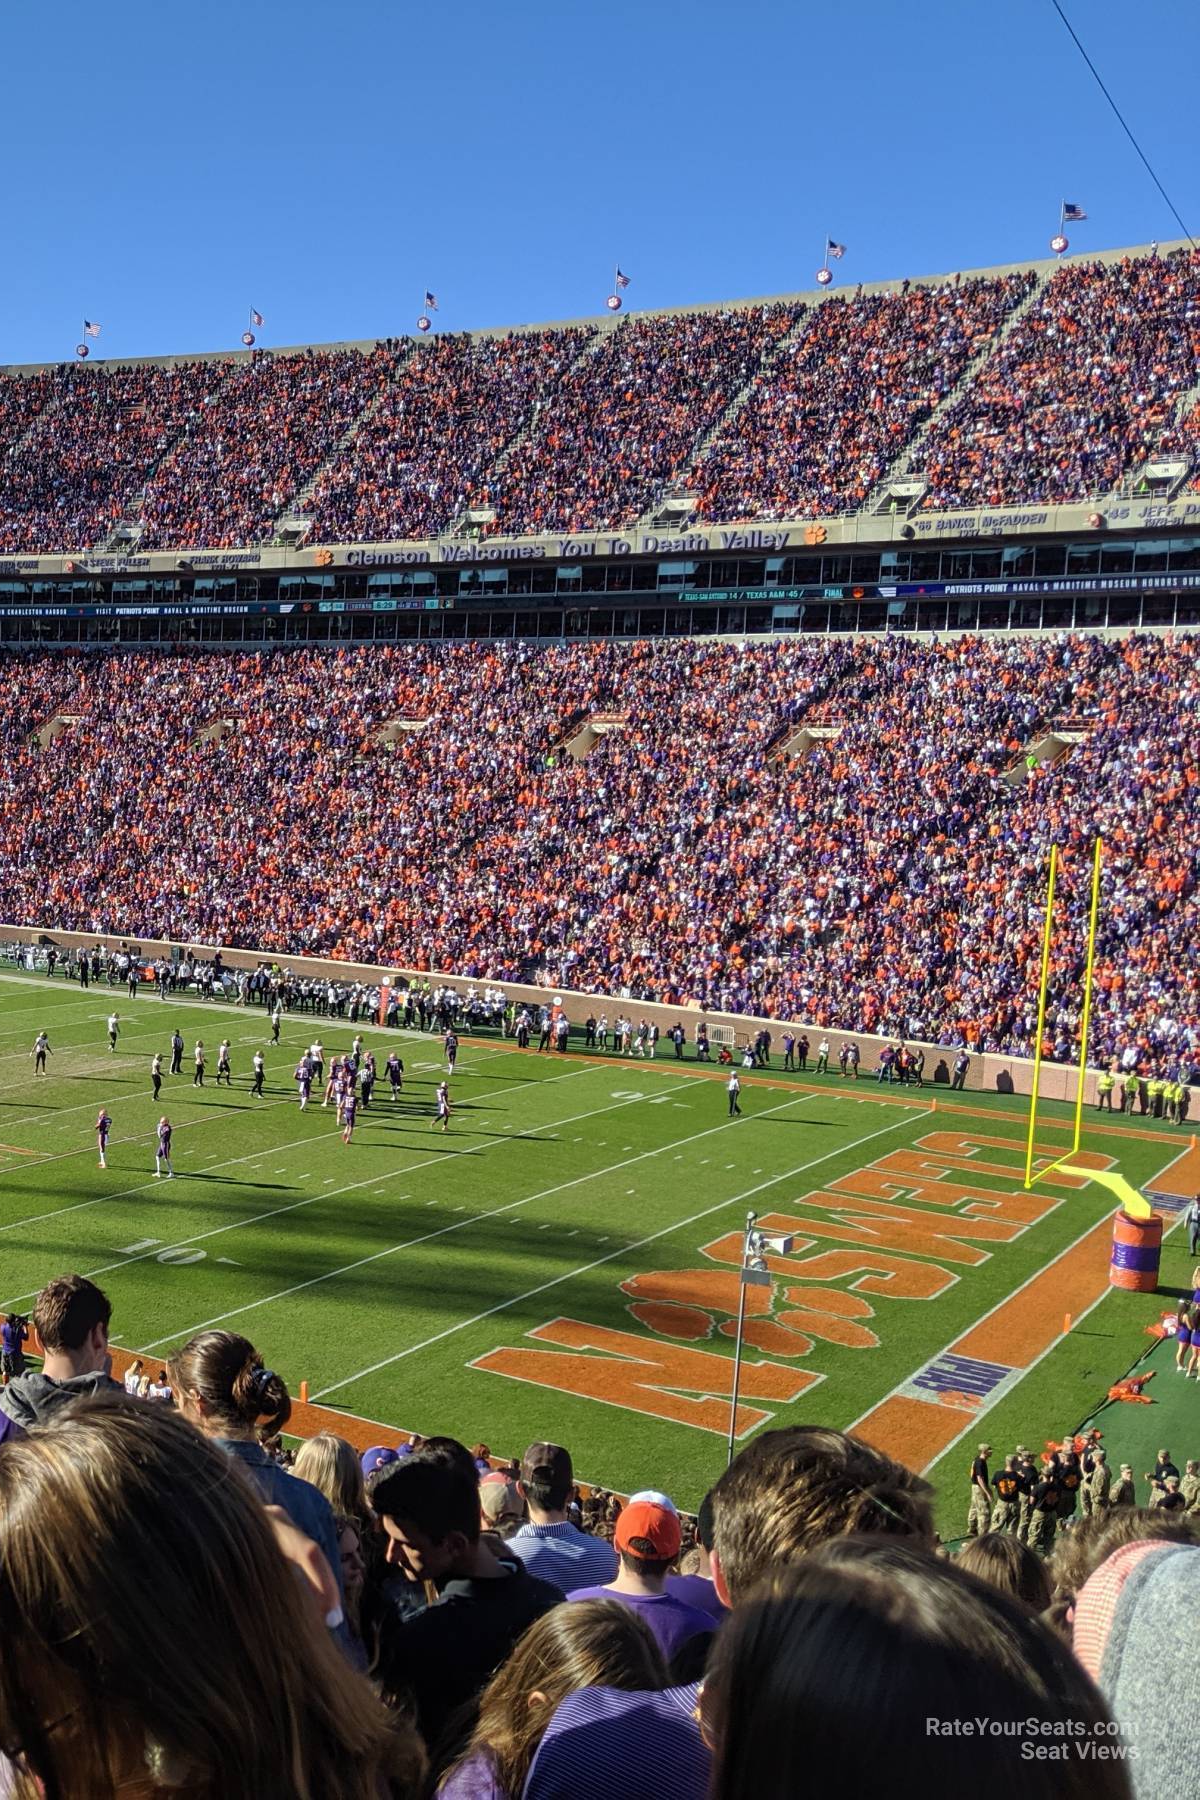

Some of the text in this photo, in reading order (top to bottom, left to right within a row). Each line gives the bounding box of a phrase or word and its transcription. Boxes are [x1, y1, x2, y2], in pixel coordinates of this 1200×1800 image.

[1138, 505, 1176, 518] JEFF
[936, 518, 976, 530] BANKS
[982, 513, 1047, 528] McFADDEN
[345, 530, 790, 566] Clemson Welcomes You To Death Valley
[222, 554, 261, 563] HOWARD
[944, 585, 982, 594] PATRIOTS
[984, 584, 1008, 593] POINT
[1012, 583, 1038, 592] NAVAL
[1053, 581, 1096, 591] MARITIME
[1101, 579, 1137, 589] MUSEUM
[1142, 578, 1178, 587] HONORS
[729, 592, 738, 600] 14
[746, 591, 767, 599] TEXAS
[769, 591, 785, 599] A&M
[788, 590, 798, 598] 45
[824, 589, 843, 597] FINAL
[115, 607, 141, 615] PATRIOTS
[143, 607, 160, 615] POINT
[192, 606, 221, 614] MARITIME
[224, 605, 248, 613] MUSEUM
[376, 601, 393, 609] 6:29
[110, 1237, 207, 1265] 10
[465, 1131, 1120, 1439] CLEMSN
